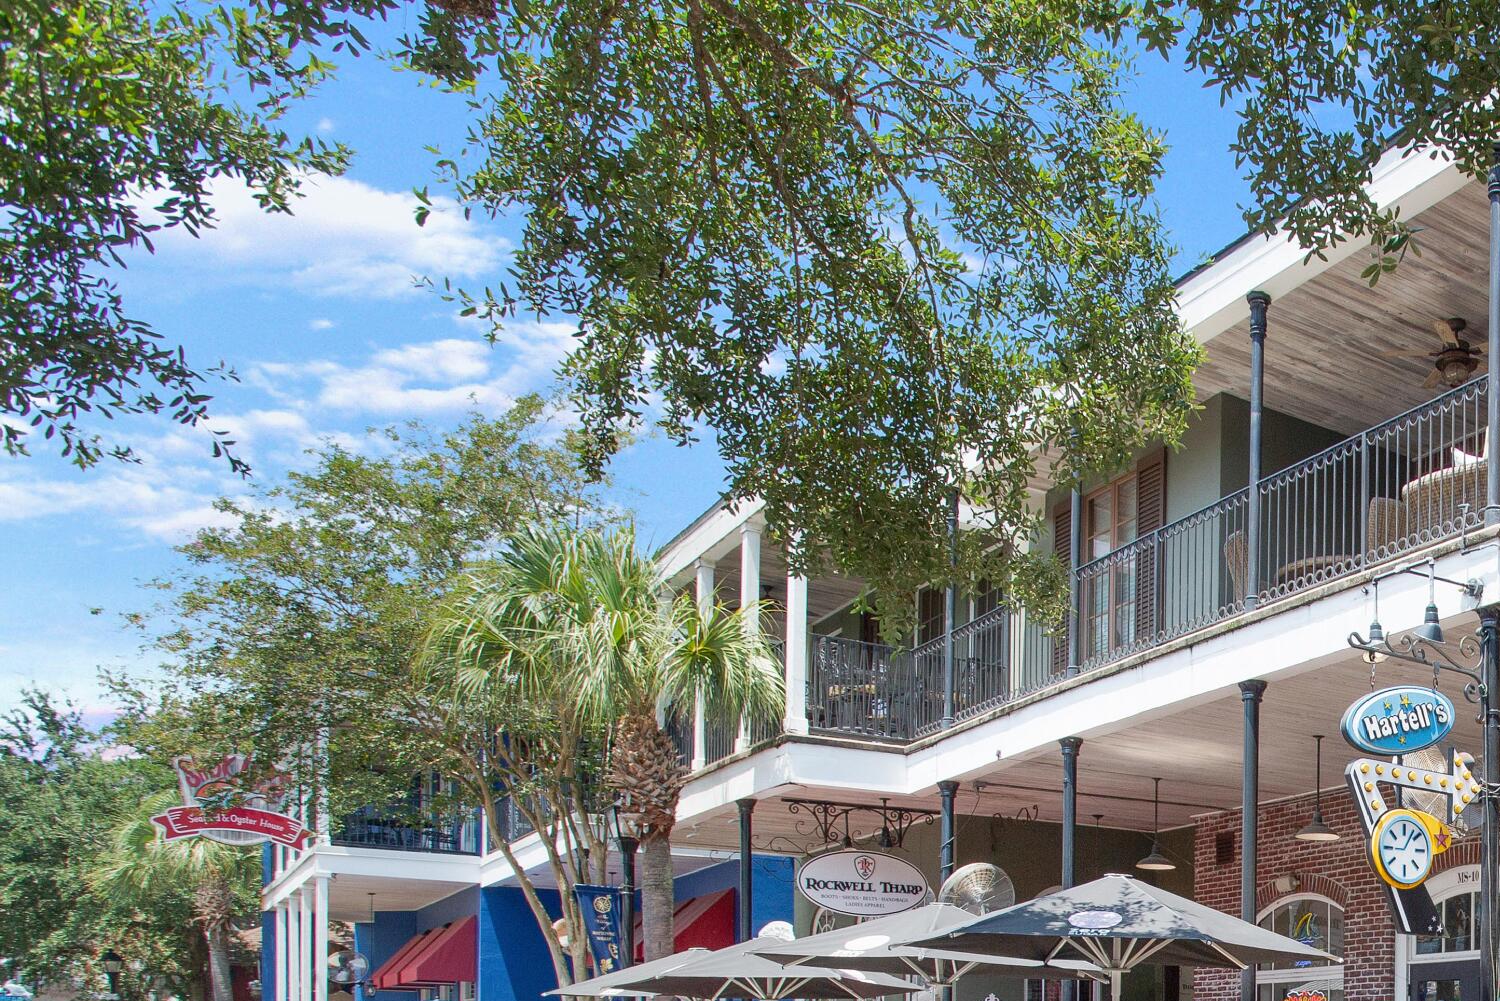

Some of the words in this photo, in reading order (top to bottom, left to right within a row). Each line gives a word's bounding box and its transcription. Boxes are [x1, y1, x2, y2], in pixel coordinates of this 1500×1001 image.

[1363, 703, 1449, 740] Hartell's
[230, 814, 257, 826] Oyster
[260, 818, 285, 832] House
[805, 878, 876, 892] ROCKWELL
[880, 882, 922, 895] THARP
